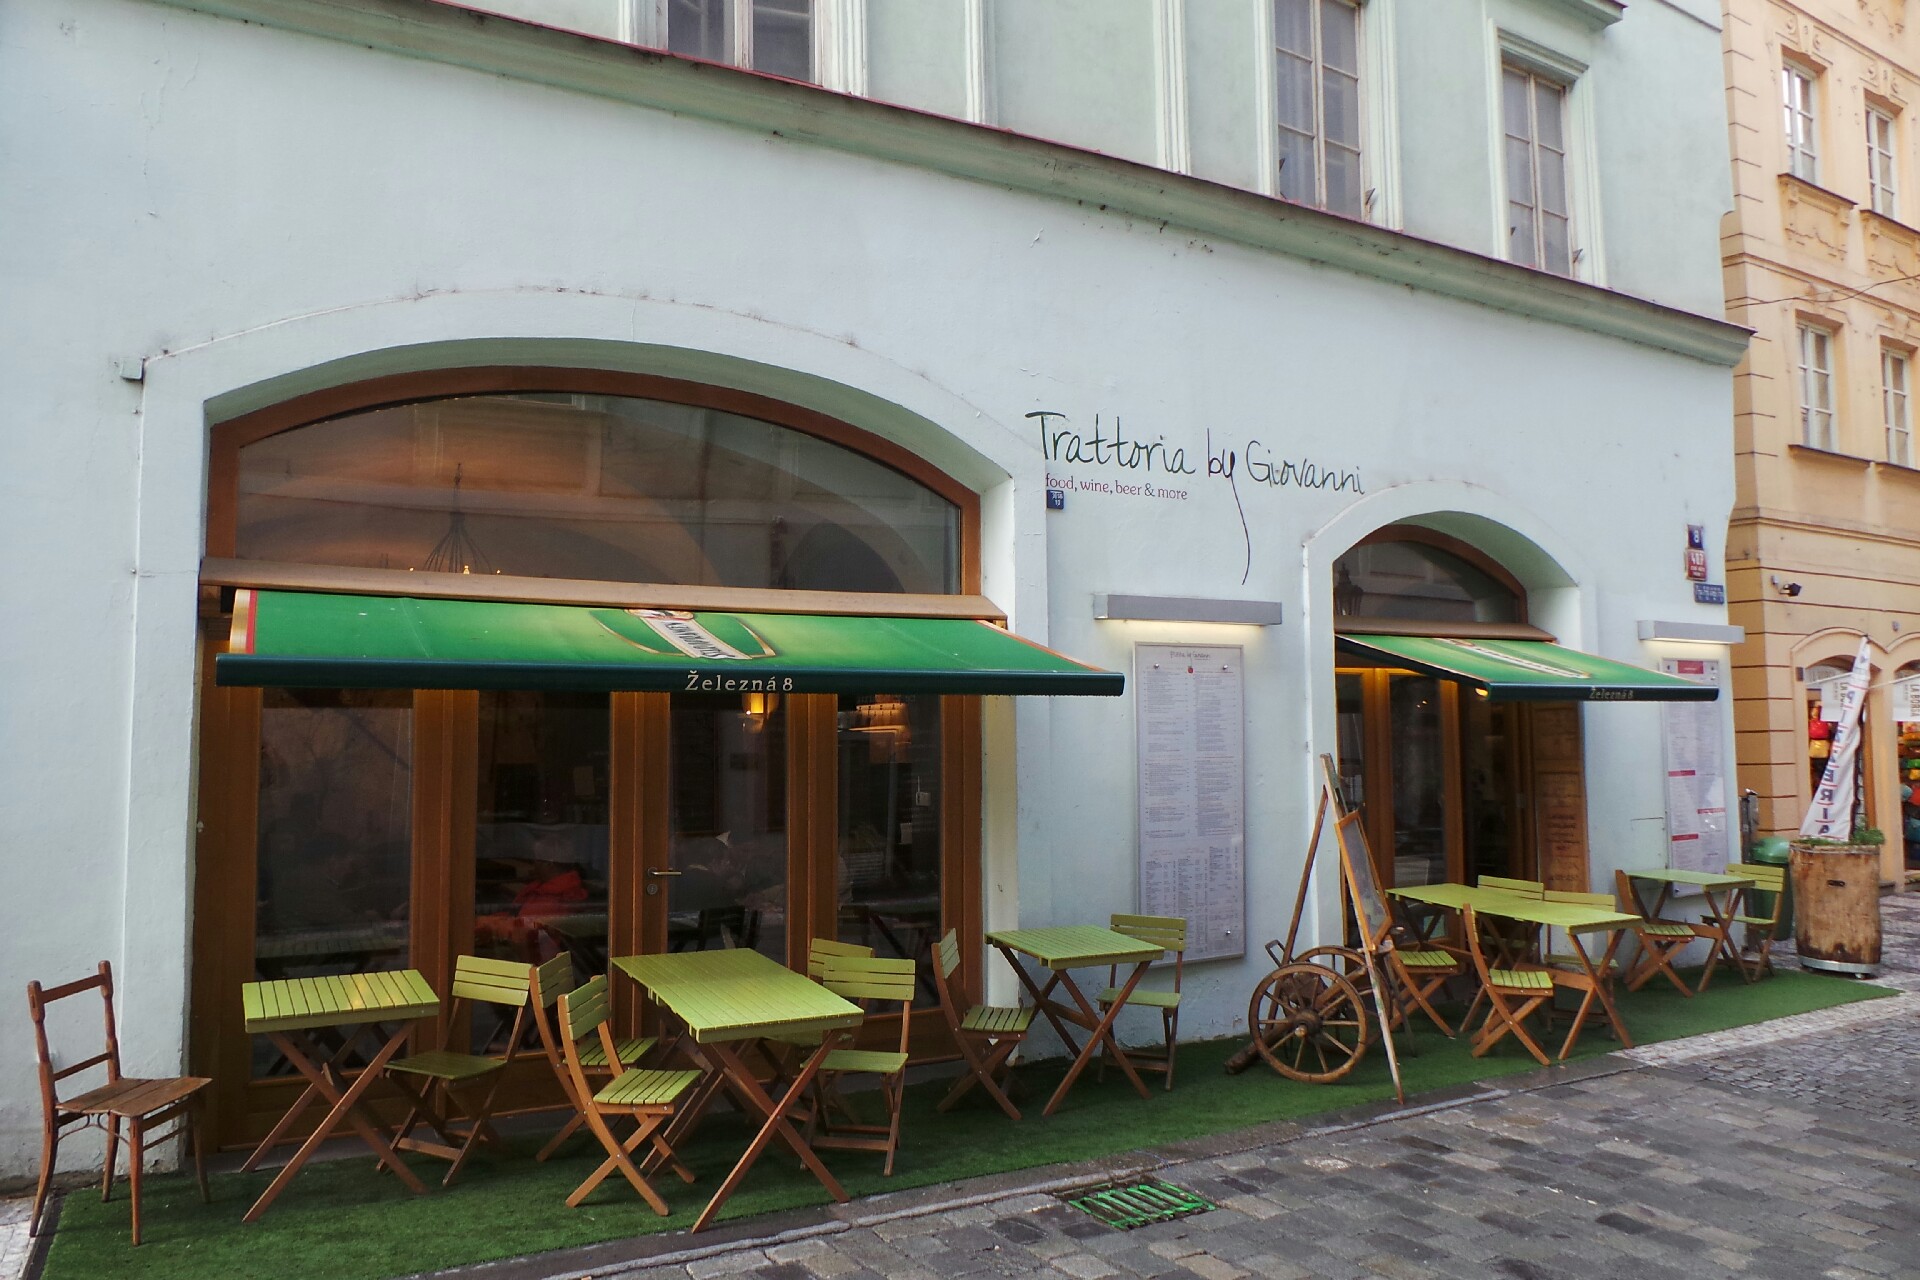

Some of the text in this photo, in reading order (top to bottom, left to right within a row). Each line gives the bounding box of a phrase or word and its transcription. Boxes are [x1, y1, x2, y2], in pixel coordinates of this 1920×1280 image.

[1025, 411, 1197, 475] Trattoria
[1246, 440, 1366, 495] Giovanni
[1045, 473, 1188, 500] food, wine, beer & more
[685, 670, 793, 691] Železná 8
